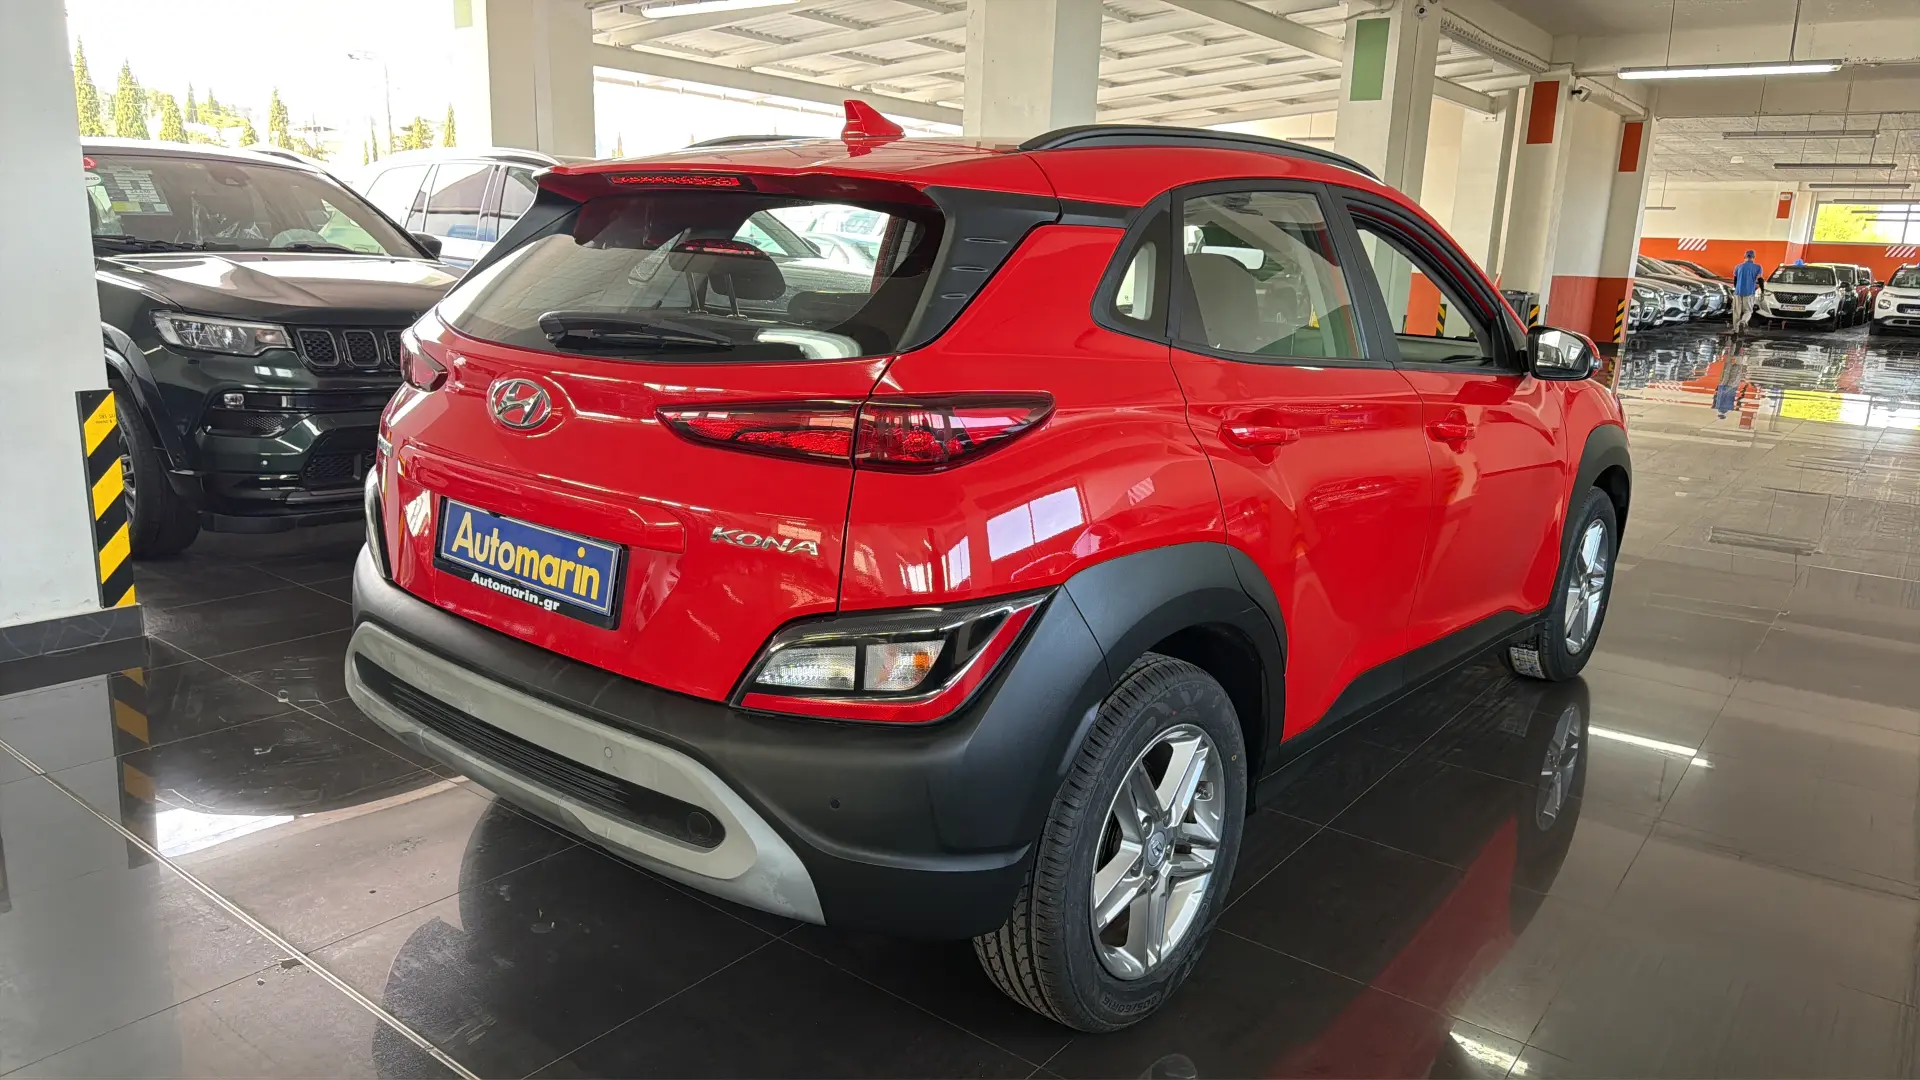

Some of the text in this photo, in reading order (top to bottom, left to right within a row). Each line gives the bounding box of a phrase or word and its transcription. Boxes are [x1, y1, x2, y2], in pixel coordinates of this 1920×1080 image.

[451, 511, 600, 600] Automarin
[711, 526, 819, 556] KONA
[471, 572, 560, 612] Automarin.gr
[1102, 995, 1157, 1013] 205/60R16
